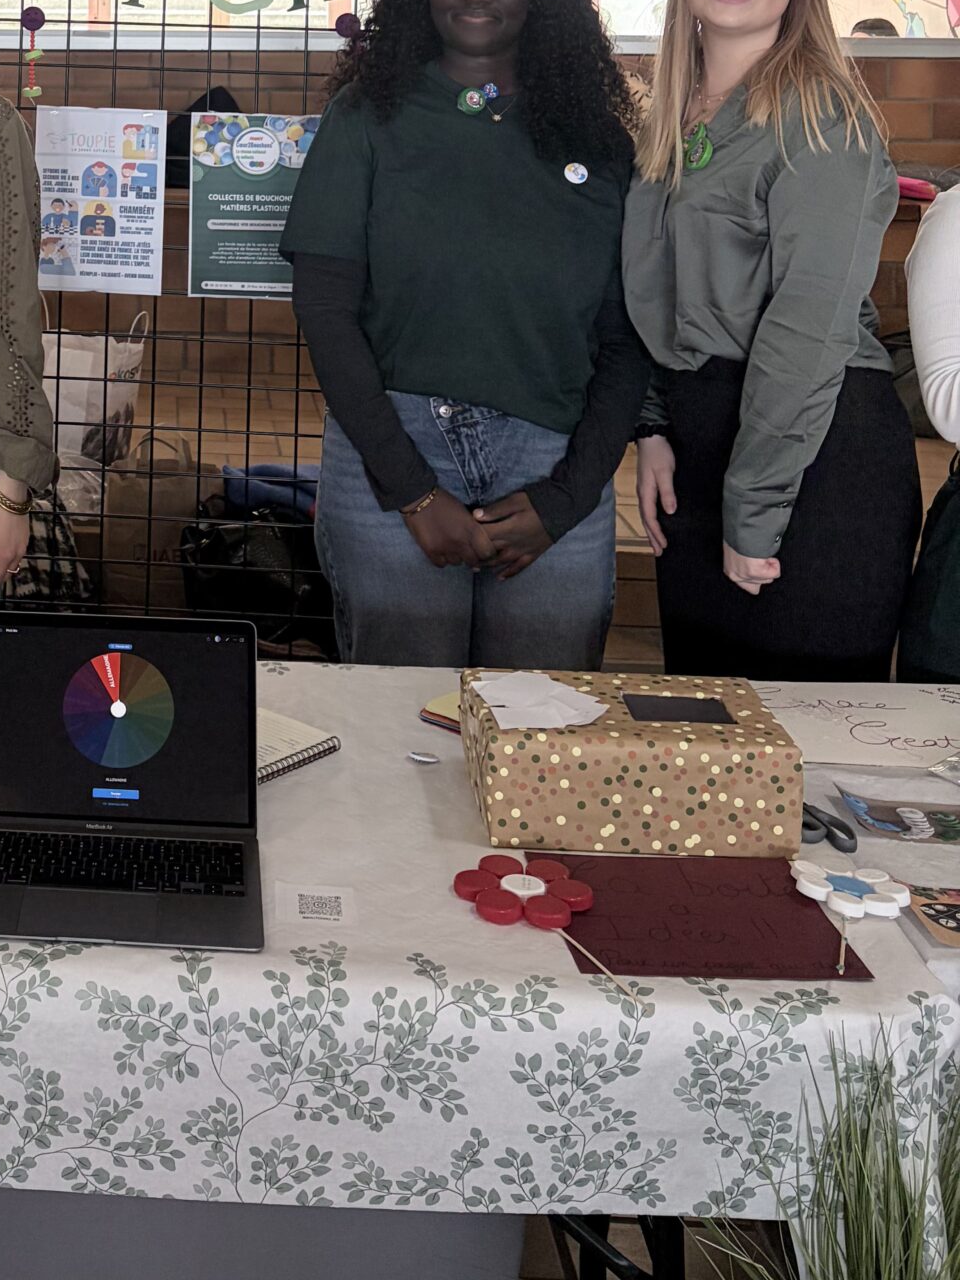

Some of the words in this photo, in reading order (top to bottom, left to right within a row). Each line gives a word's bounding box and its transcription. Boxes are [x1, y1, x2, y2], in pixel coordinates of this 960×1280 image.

[119, 205, 155, 215] CHAMBÉRY
[220, 204, 251, 212] MATIÈRES
[104, 654, 116, 688] ALLEMAGNE
[845, 715, 960, 750] Creat
